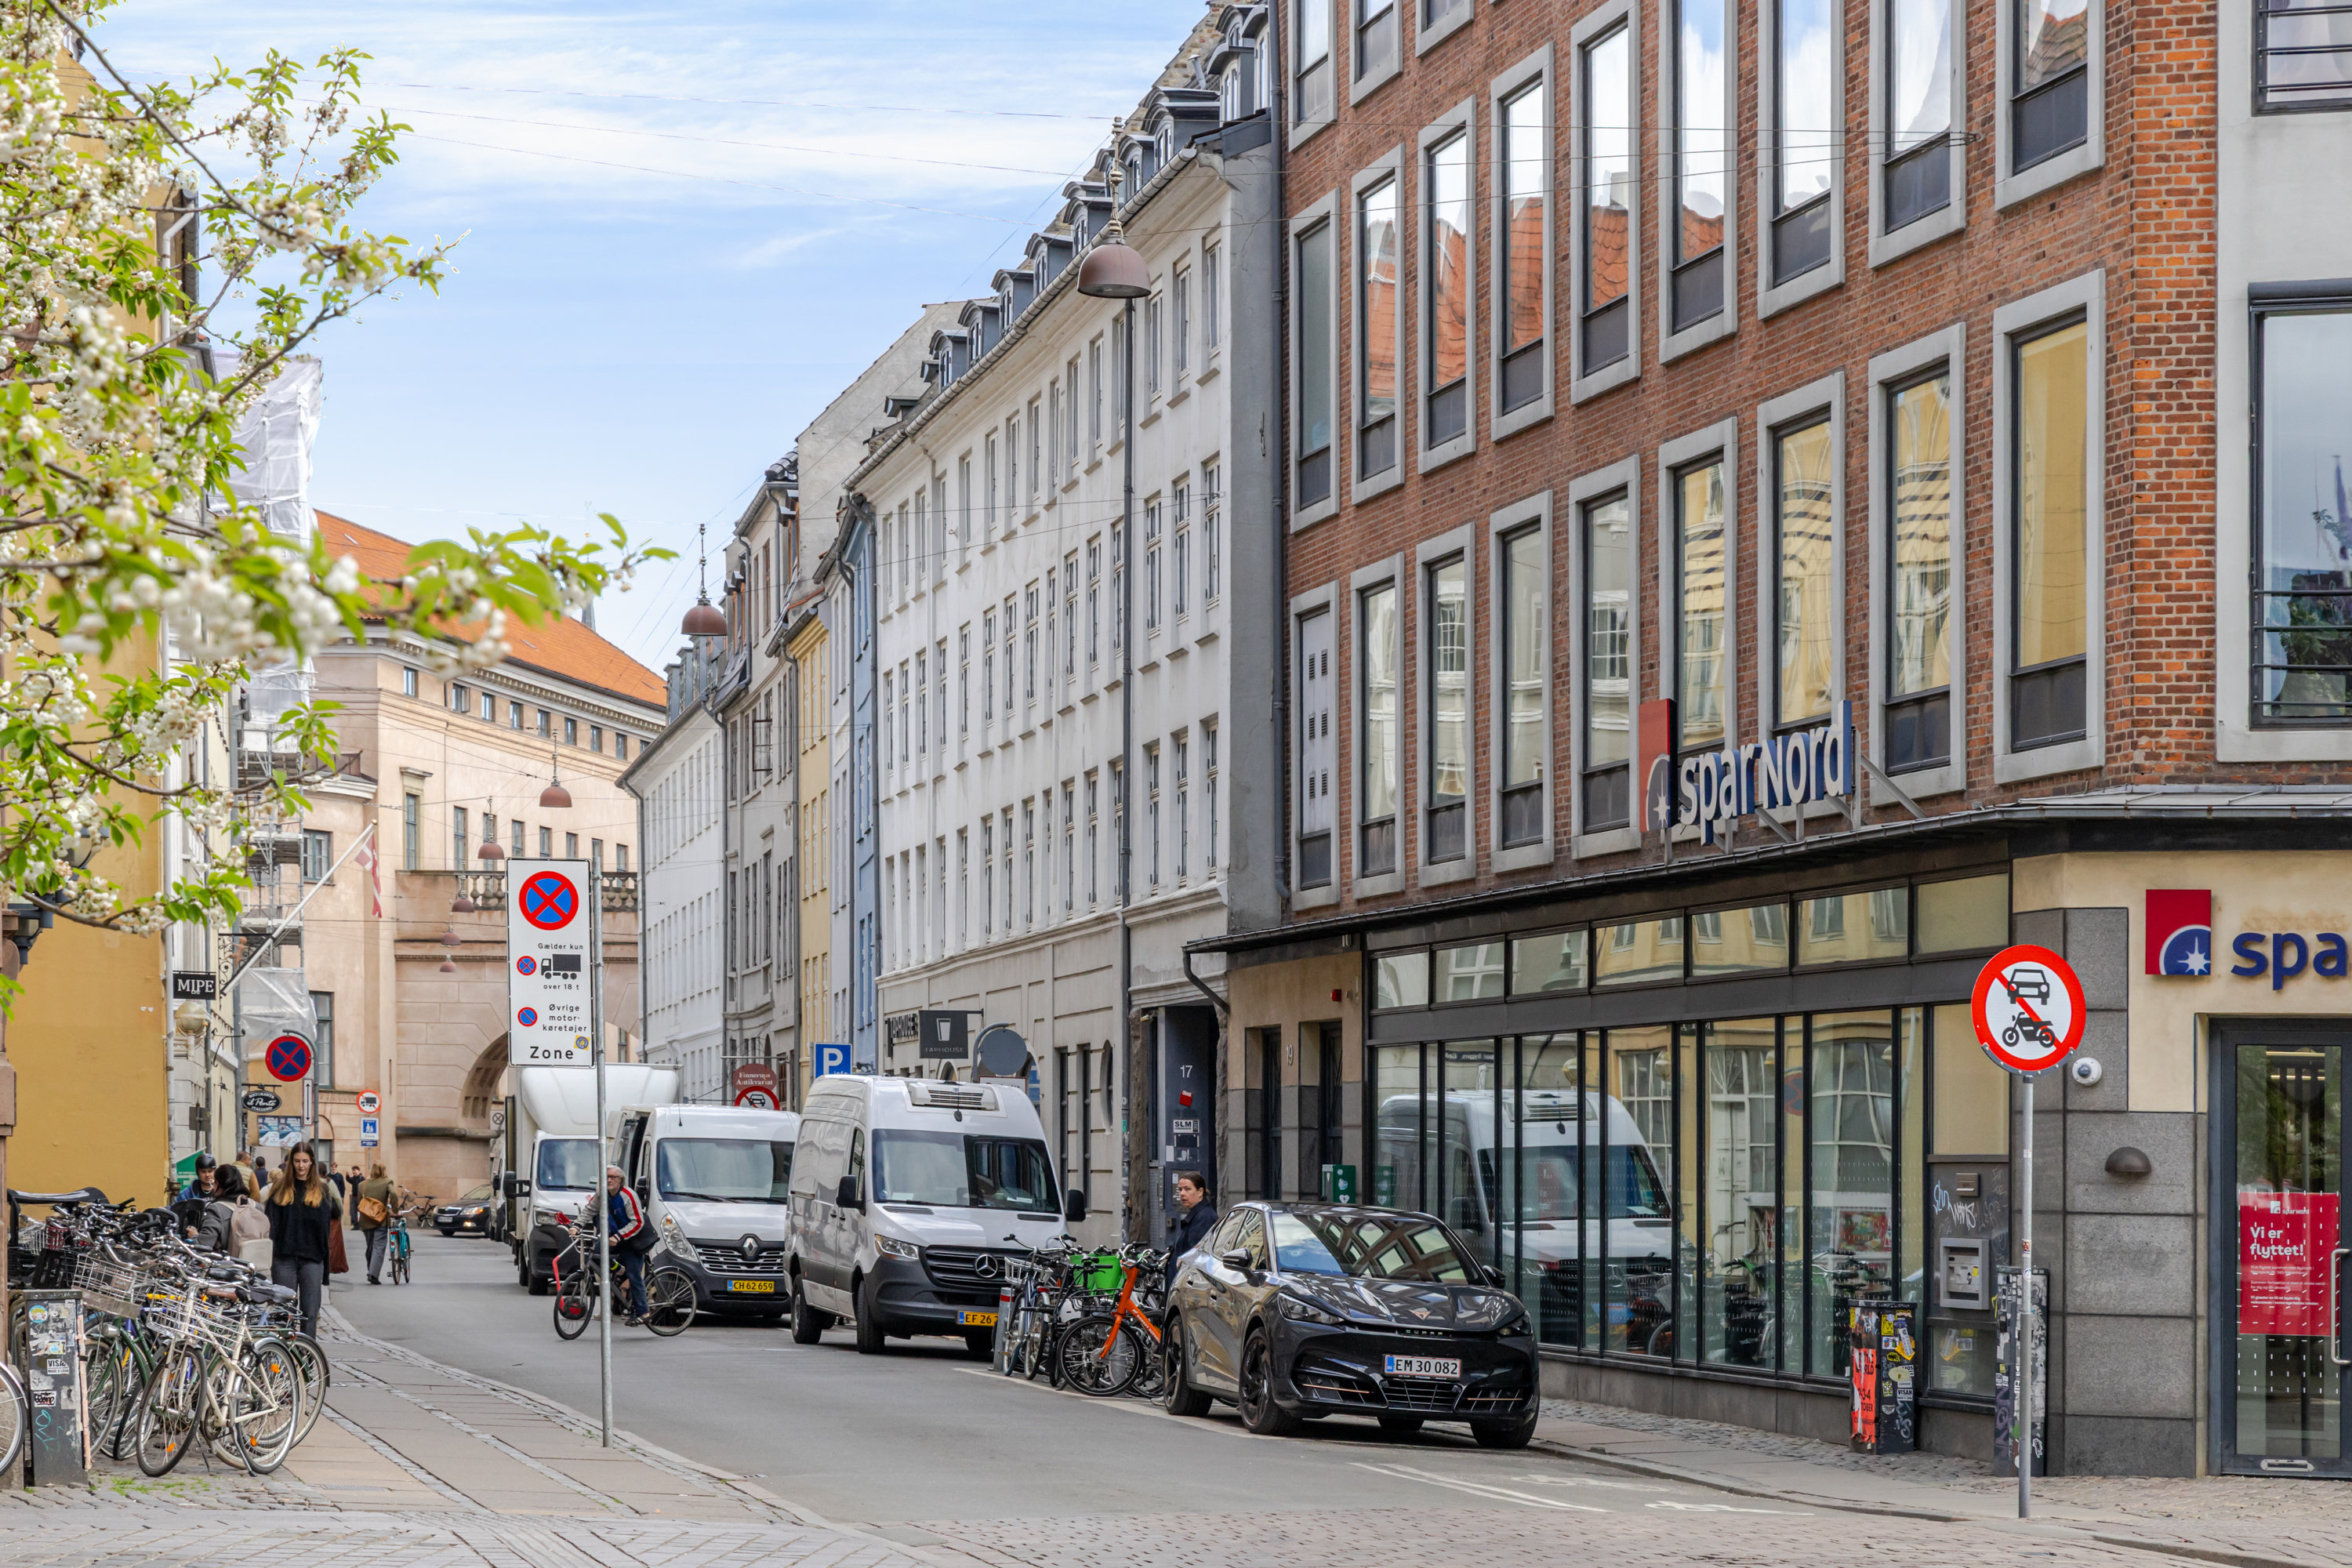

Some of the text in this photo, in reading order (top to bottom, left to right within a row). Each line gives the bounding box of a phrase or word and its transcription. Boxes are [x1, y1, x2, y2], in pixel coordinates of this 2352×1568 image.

[1680, 699, 1853, 846] spar Nord
[2230, 932, 2347, 990] spa
[177, 978, 214, 993] MIPE
[543, 1024, 587, 1033] køretøjer
[530, 1046, 574, 1059] Zone
[1286, 1044, 1293, 1066] 19
[823, 1047, 843, 1075] P
[1180, 1065, 1192, 1078] 17
[2250, 1226, 2283, 1239] Vi er
[2249, 1243, 2304, 1258] flyttet!
[746, 1282, 757, 1290] 62
[965, 1314, 978, 1323] EF
[980, 1315, 992, 1324] 26
[1396, 1359, 1457, 1375] EM 30 082
